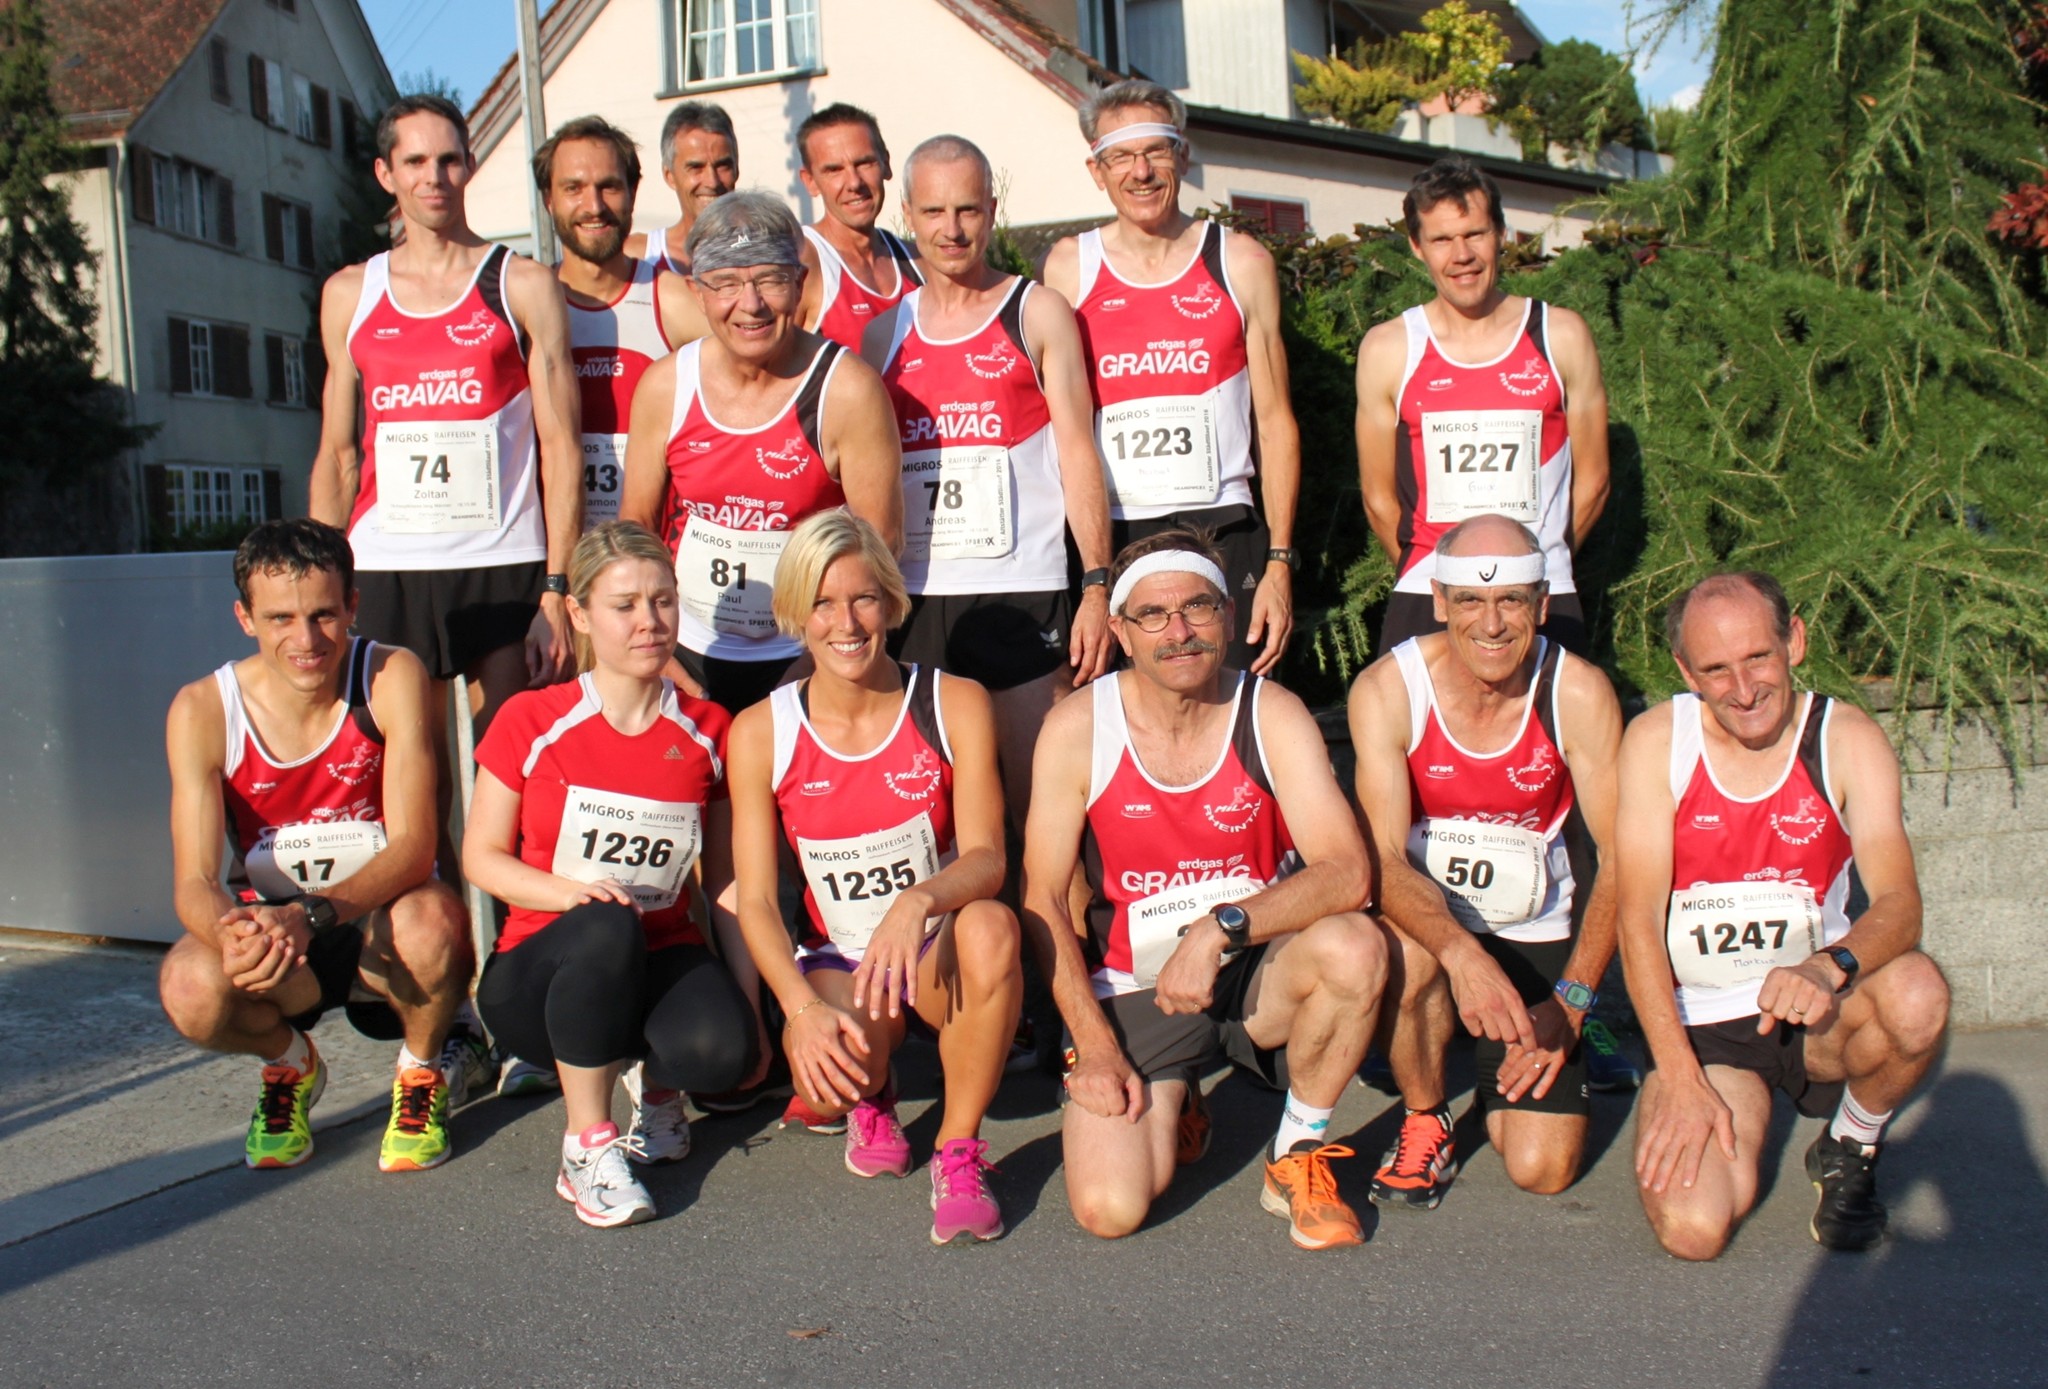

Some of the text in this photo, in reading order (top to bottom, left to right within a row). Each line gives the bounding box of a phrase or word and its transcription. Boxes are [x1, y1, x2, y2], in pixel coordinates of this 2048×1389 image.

[1171, 294, 1222, 319] RHEINTAL
[446, 322, 496, 347] RHEINTAL
[1147, 338, 1186, 350] erdgas
[964, 353, 1017, 379] RHEINTAL
[973, 354, 1009, 363] MILA
[1098, 350, 1210, 379] GRAVAG
[419, 368, 457, 381] erdgas
[574, 361, 625, 378] RAVAG
[371, 379, 482, 411] GRAVAG
[940, 401, 978, 413] erdgas
[1106, 405, 1195, 424] MIGROS RAIFFEISEN
[386, 430, 476, 444] MIGROS RAIFFEISEN
[902, 413, 1003, 443] GRAVAG
[1432, 420, 1526, 433] MIGROS RAIFFEISEN
[1111, 426, 1193, 460] 1223
[755, 448, 810, 480] RHEINTAL
[764, 450, 803, 461] MILA
[902, 455, 988, 473] MIGROS RAIFFEISEN
[1439, 443, 1520, 473] 1227
[410, 454, 450, 484] 74
[414, 489, 448, 500] Zoltan
[585, 498, 617, 508] amon
[724, 495, 765, 509] erdgas
[923, 479, 963, 511] 78
[682, 499, 789, 531] GRAVAG
[925, 516, 966, 527] Andreas
[690, 529, 781, 550] MIGROS RAIFFEISEN
[710, 558, 747, 590] 81
[717, 592, 742, 605] Paul
[884, 769, 941, 801] RHEINTAL
[895, 770, 934, 781] MILA
[578, 802, 685, 823] MIGROS RAIFFEISEN
[1203, 797, 1262, 833] RHEINTAL
[1215, 804, 1254, 813] MILA
[1770, 813, 1827, 845] RHEINTAL
[1780, 815, 1817, 824] MILA
[259, 832, 363, 852] MIGROS RAIFFEISEN
[581, 828, 674, 868] 1236
[808, 833, 912, 862] MIGROS RAIFFEISEN
[1421, 830, 1526, 847] MIGROS RAIFFEISEN
[291, 858, 336, 882] 17
[1177, 858, 1223, 870] erdgas
[1445, 856, 1494, 890] 50
[822, 858, 916, 902] 1235
[1121, 865, 1251, 896] GRAVAG
[1141, 886, 1251, 919] MIGROS RAIFFEISEN
[1450, 890, 1483, 903] Berni
[1681, 892, 1794, 912] MIGROS RAIFFEISEN
[1689, 919, 1789, 956] 1247
